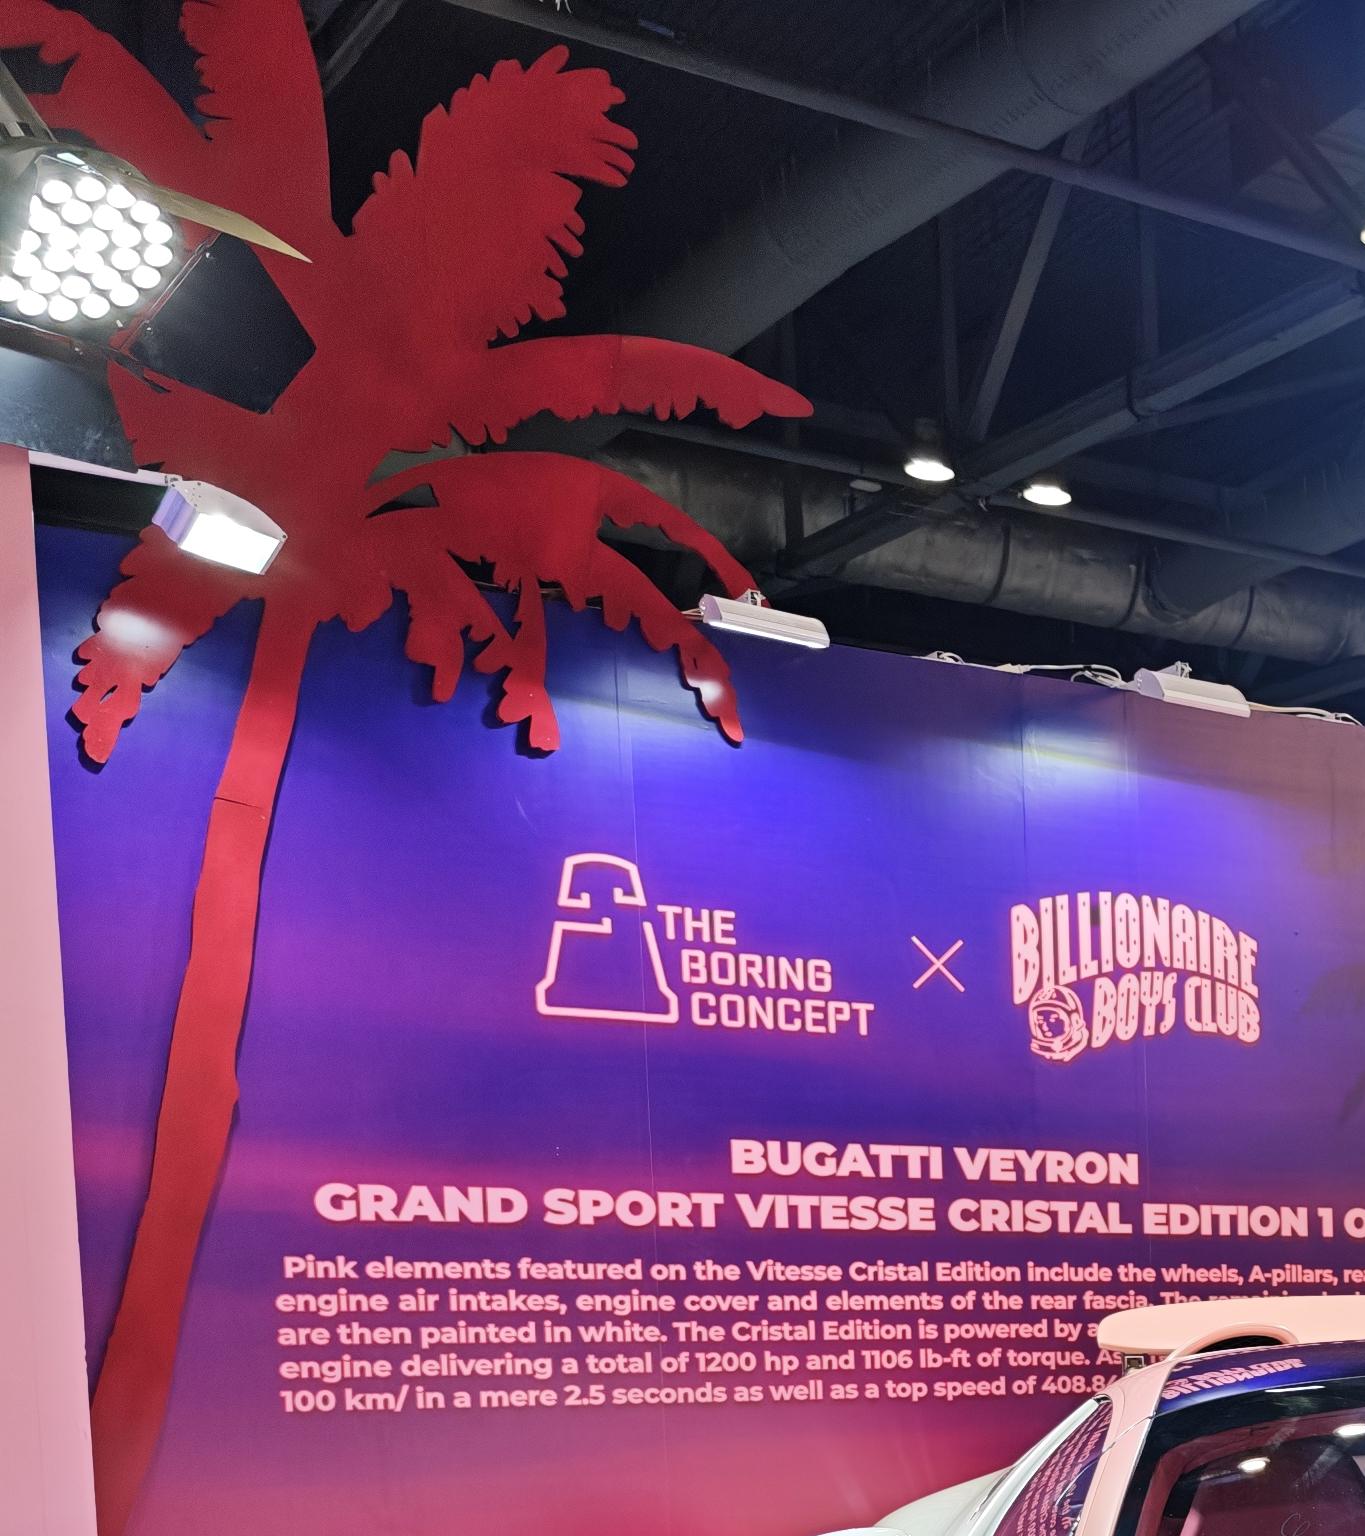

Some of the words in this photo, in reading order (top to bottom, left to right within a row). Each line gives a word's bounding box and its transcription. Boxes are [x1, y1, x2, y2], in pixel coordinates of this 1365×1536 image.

[656, 903, 737, 946] THE
[680, 948, 832, 993] BORING
[1010, 891, 1259, 1006] BILLIONAIRE
[690, 991, 875, 1036] CONCEPT
[1090, 971, 1178, 1049] BOYS
[1184, 975, 1260, 1044] CLUB
[730, 1138, 943, 1180] BUGATTI
[953, 1147, 1139, 1185] VEYRON
[313, 1182, 528, 1224] GRAND
[543, 1187, 725, 1228] SPORT
[734, 1193, 936, 1231] VITESSE
[947, 1198, 1133, 1234] CRISTAL
[1142, 1202, 1309, 1237] EDITION
[1317, 1207, 1334, 1238] 1
[283, 1254, 359, 1279] Pink
[365, 1255, 512, 1280] elements
[517, 1257, 643, 1280] featured
[650, 1263, 687, 1281] on
[692, 1259, 741, 1281] the
[745, 1258, 843, 1282] Vitesse
[848, 1259, 929, 1282] Cristal
[935, 1260, 1022, 1282] Edition
[1027, 1260, 1113, 1282] include
[1116, 1262, 1157, 1283] the
[1160, 1263, 1244, 1286] wheels,
[1248, 1263, 1339, 1287] A-pillars,
[275, 1287, 390, 1317] engine
[398, 1287, 440, 1312] air
[448, 1287, 568, 1315] intakes,
[575, 1288, 676, 1316] engine
[683, 1294, 760, 1312] cover
[767, 1289, 818, 1311] and
[825, 1289, 944, 1311] elements
[950, 1290, 977, 1311] of
[981, 1290, 1024, 1310] the
[1030, 1294, 1078, 1310] rear
[1082, 1289, 1154, 1312] fascia.
[277, 1327, 331, 1346] are
[336, 1321, 412, 1345] then
[420, 1320, 537, 1349] painted
[543, 1319, 572, 1343] in
[577, 1319, 668, 1343] white.
[671, 1320, 726, 1342] The
[731, 1319, 816, 1342] Cristal
[822, 1318, 912, 1341] Edition
[917, 1318, 939, 1340] is
[943, 1318, 1049, 1344] powered
[1053, 1318, 1083, 1342] by
[279, 1353, 393, 1384] engine
[400, 1352, 553, 1380] delivering
[561, 1357, 579, 1374] a
[585, 1351, 653, 1374] total
[660, 1351, 690, 1373] of
[694, 1351, 757, 1373] 1200
[764, 1350, 800, 1376] hp
[805, 1349, 856, 1371] and
[861, 1349, 914, 1370] 1106
[919, 1347, 972, 1369] lb-ft
[976, 1347, 1003, 1368] of
[1006, 1349, 1091, 1370] torque.
[279, 1389, 337, 1413] 100
[344, 1384, 410, 1412] km/
[415, 1385, 446, 1409] in
[453, 1391, 472, 1409] a
[479, 1389, 558, 1408] mere
[563, 1384, 606, 1406] 2.5
[612, 1381, 728, 1405] seconds
[733, 1385, 764, 1402] as
[768, 1379, 824, 1401] well
[829, 1383, 859, 1400] as
[864, 1383, 880, 1399] a
[884, 1379, 929, 1402] top
[933, 1375, 1006, 1401] speed
[1011, 1375, 1038, 1395] of
